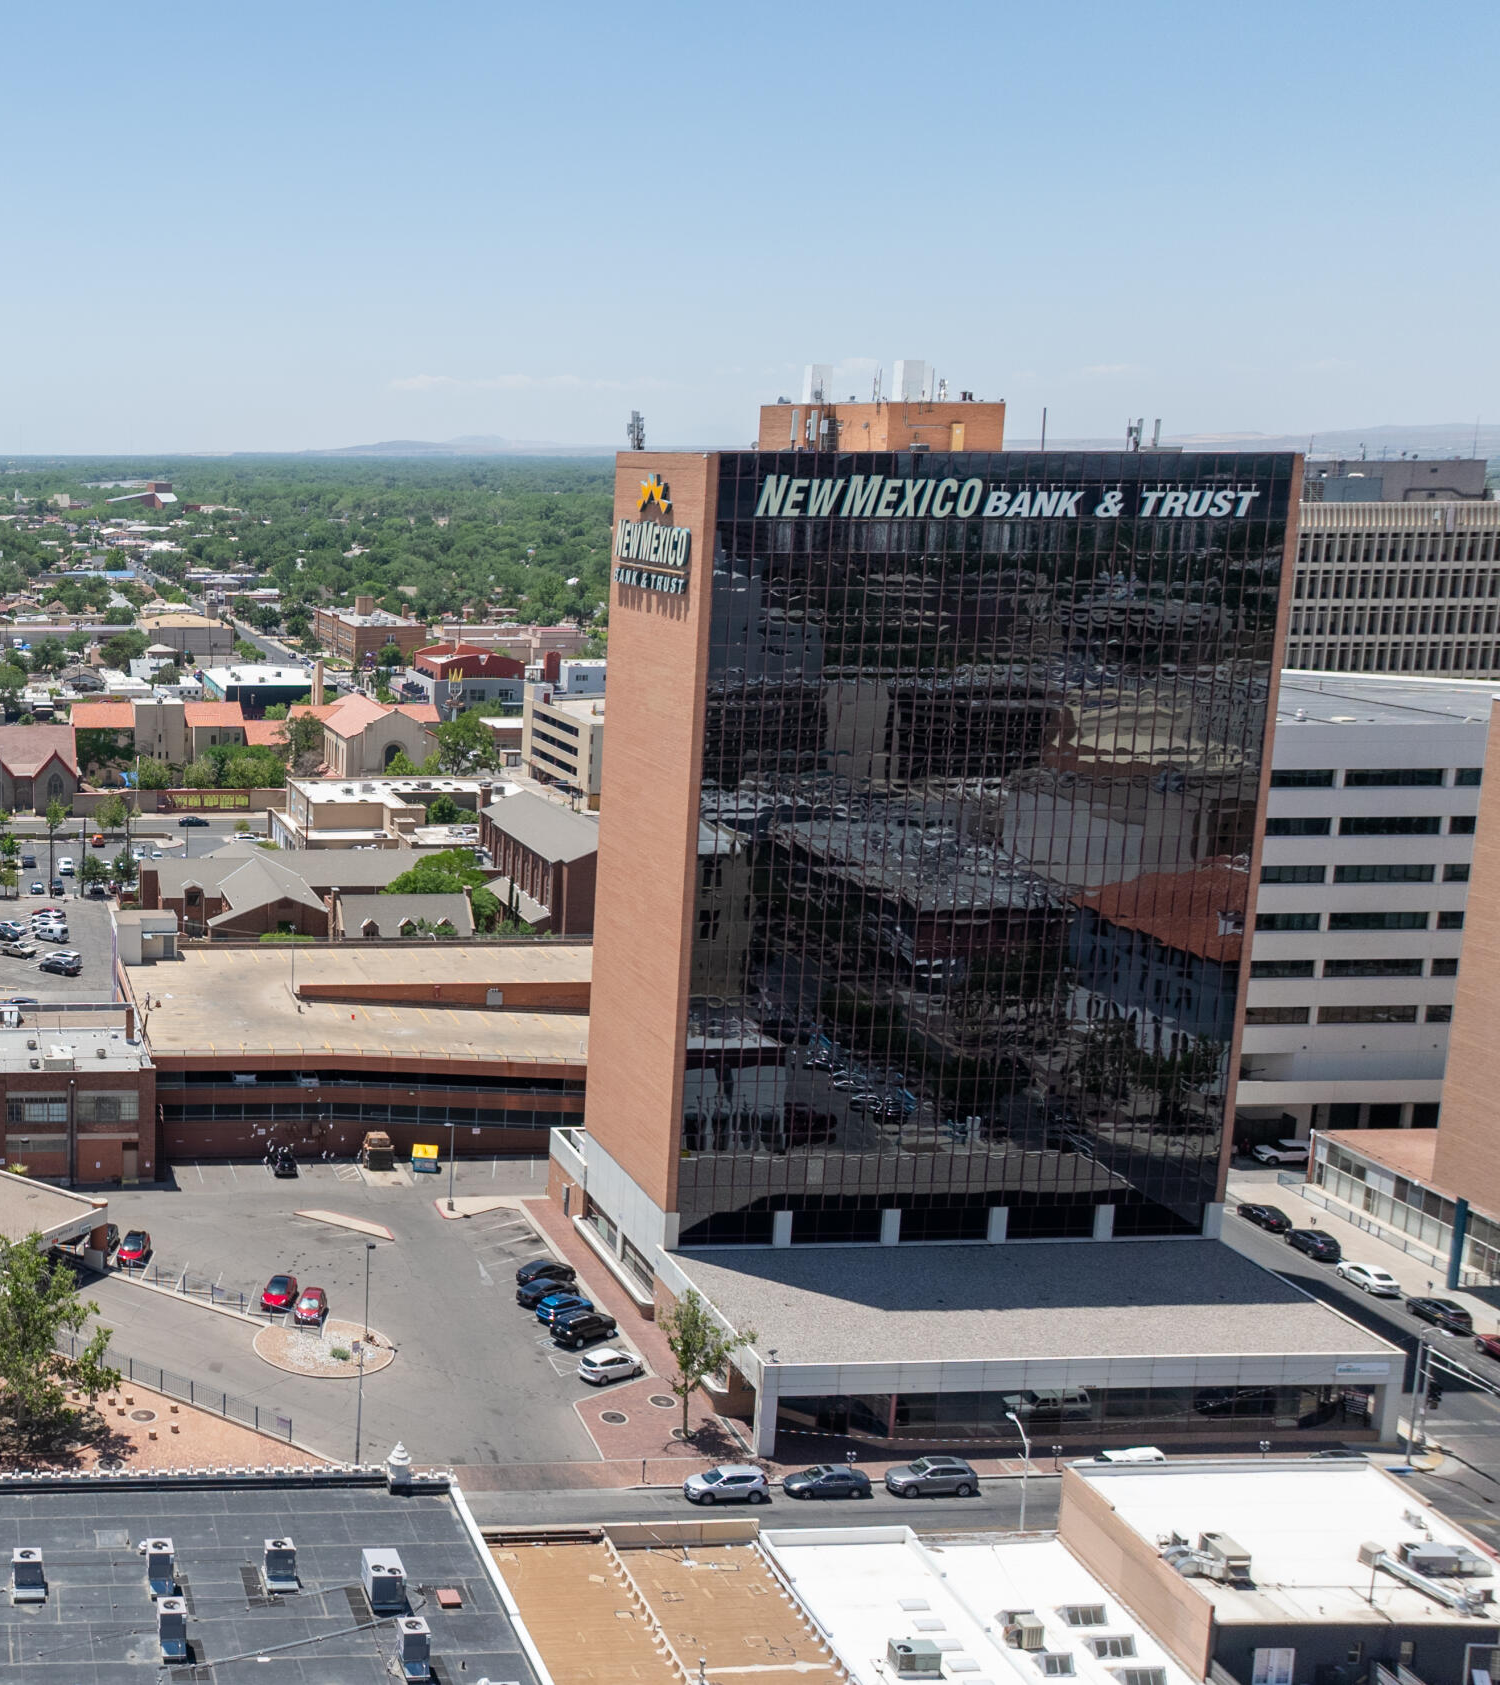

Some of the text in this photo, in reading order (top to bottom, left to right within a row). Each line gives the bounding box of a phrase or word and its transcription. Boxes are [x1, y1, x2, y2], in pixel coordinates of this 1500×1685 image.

[983, 490, 1084, 518] BANK
[1094, 491, 1123, 518] &
[1140, 490, 1260, 518] TRUST
[614, 568, 685, 595] BANK & TRUST
